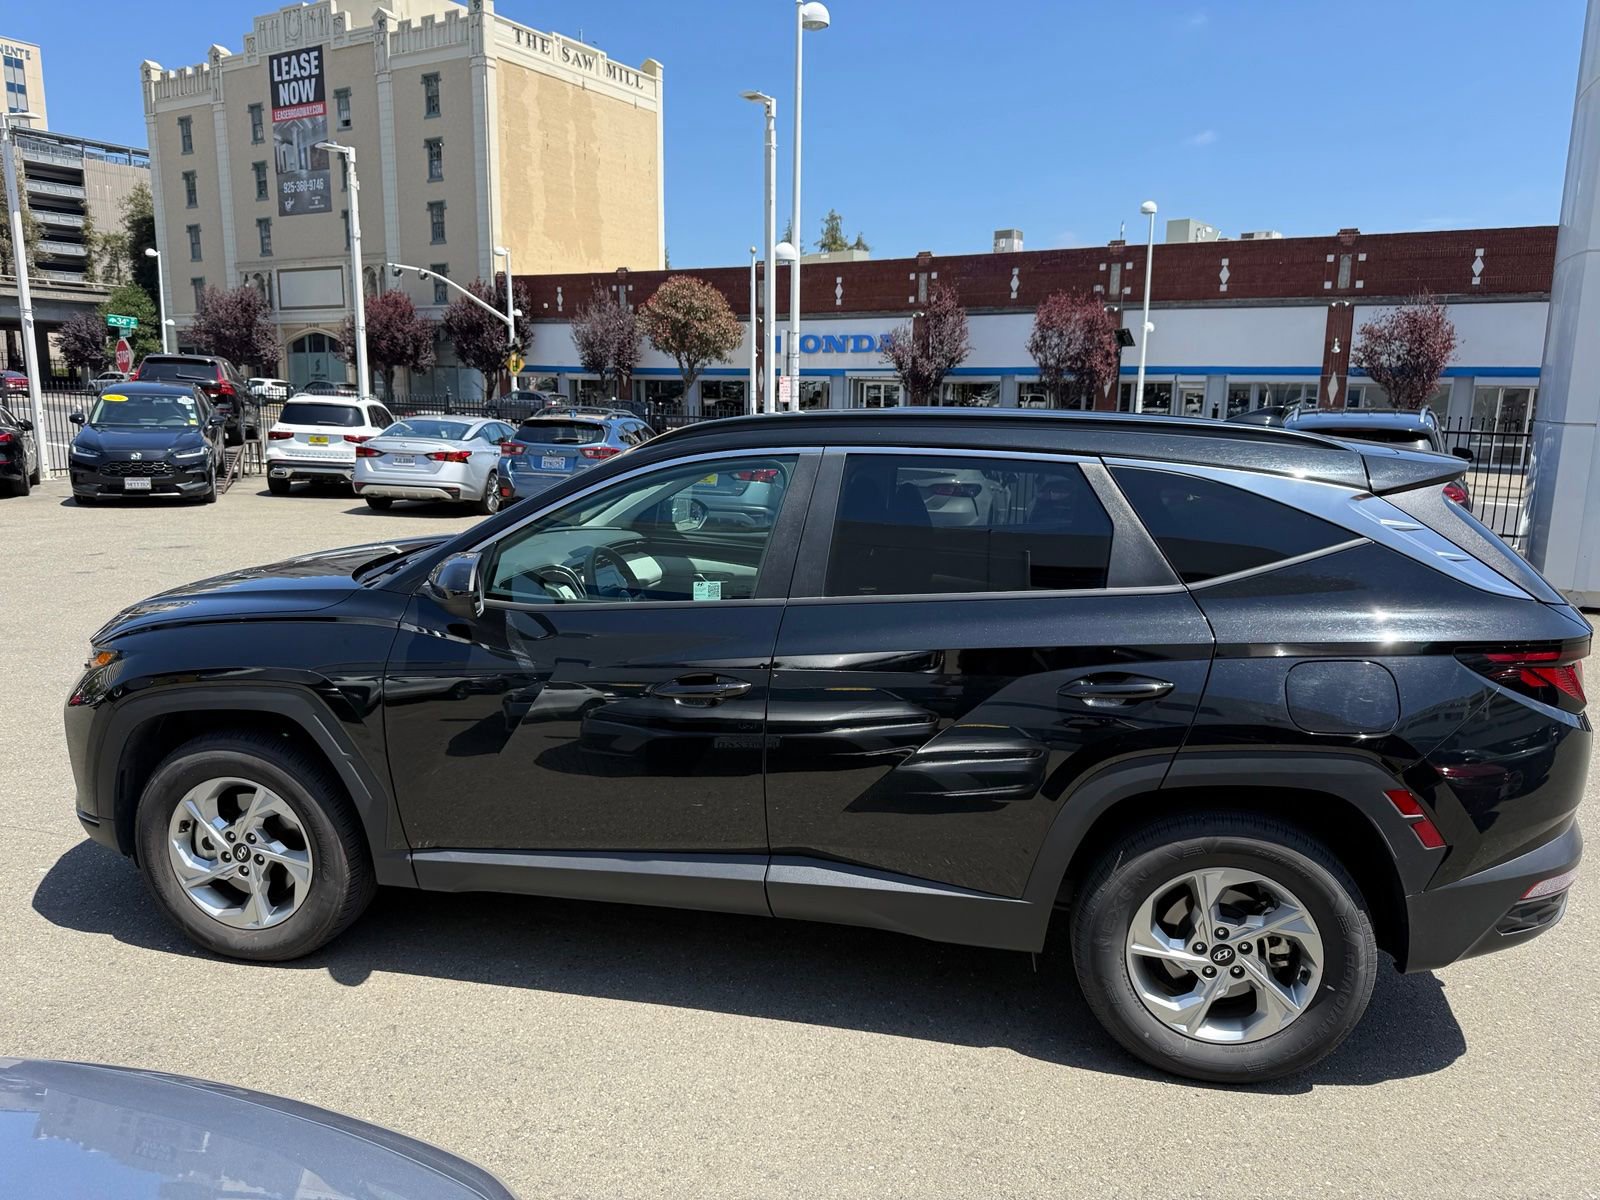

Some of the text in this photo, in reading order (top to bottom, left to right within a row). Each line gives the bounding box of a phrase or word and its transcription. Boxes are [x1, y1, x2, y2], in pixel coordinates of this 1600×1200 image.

[273, 51, 319, 82] LEASE
[511, 26, 643, 89] THE SAW MILL
[278, 78, 316, 107] NOW
[117, 350, 129, 363] STOP
[775, 334, 897, 354] ONDA
